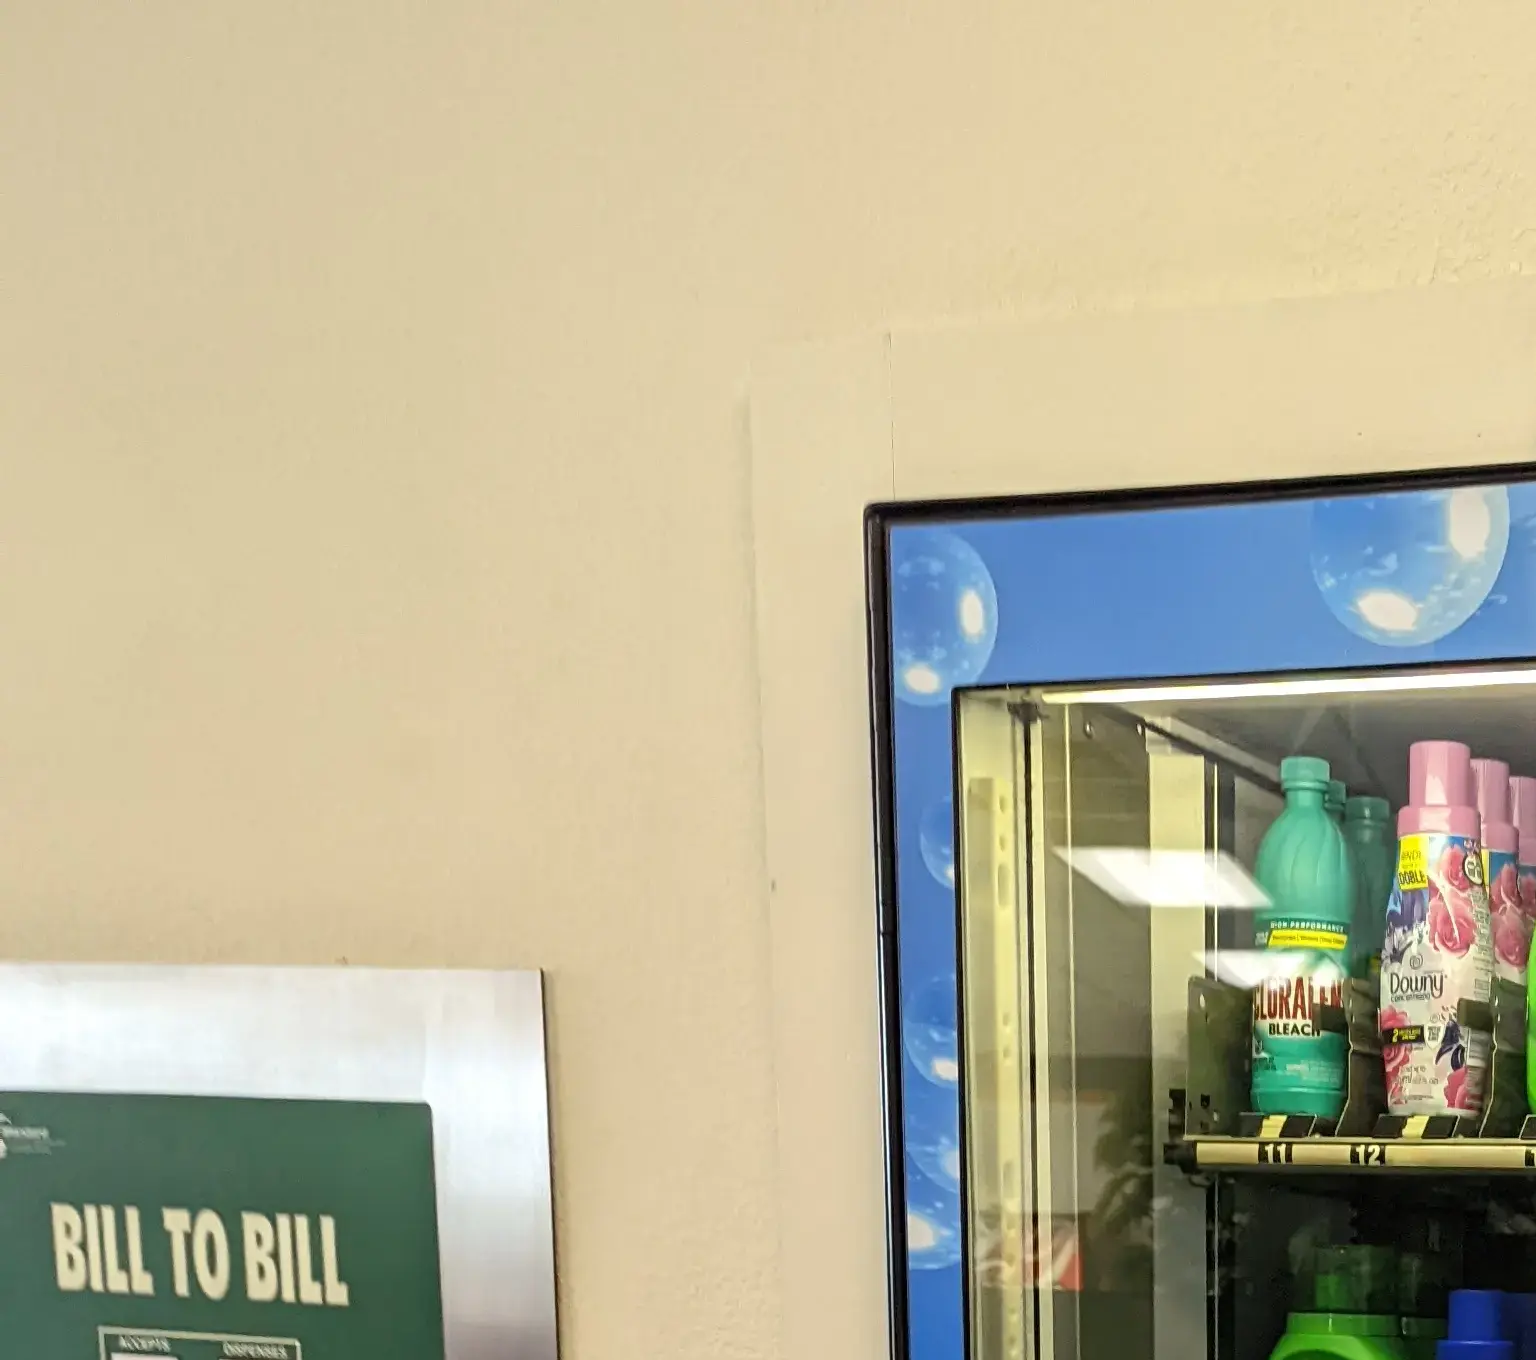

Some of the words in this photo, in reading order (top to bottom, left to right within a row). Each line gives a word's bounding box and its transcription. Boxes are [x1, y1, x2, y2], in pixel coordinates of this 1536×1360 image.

[1390, 972, 1443, 999] Downy
[1265, 1143, 1286, 1164] 11
[1355, 1144, 1381, 1166] 12
[50, 1202, 156, 1297] BILL
[162, 1207, 231, 1300] TO
[241, 1210, 350, 1306] BILL
